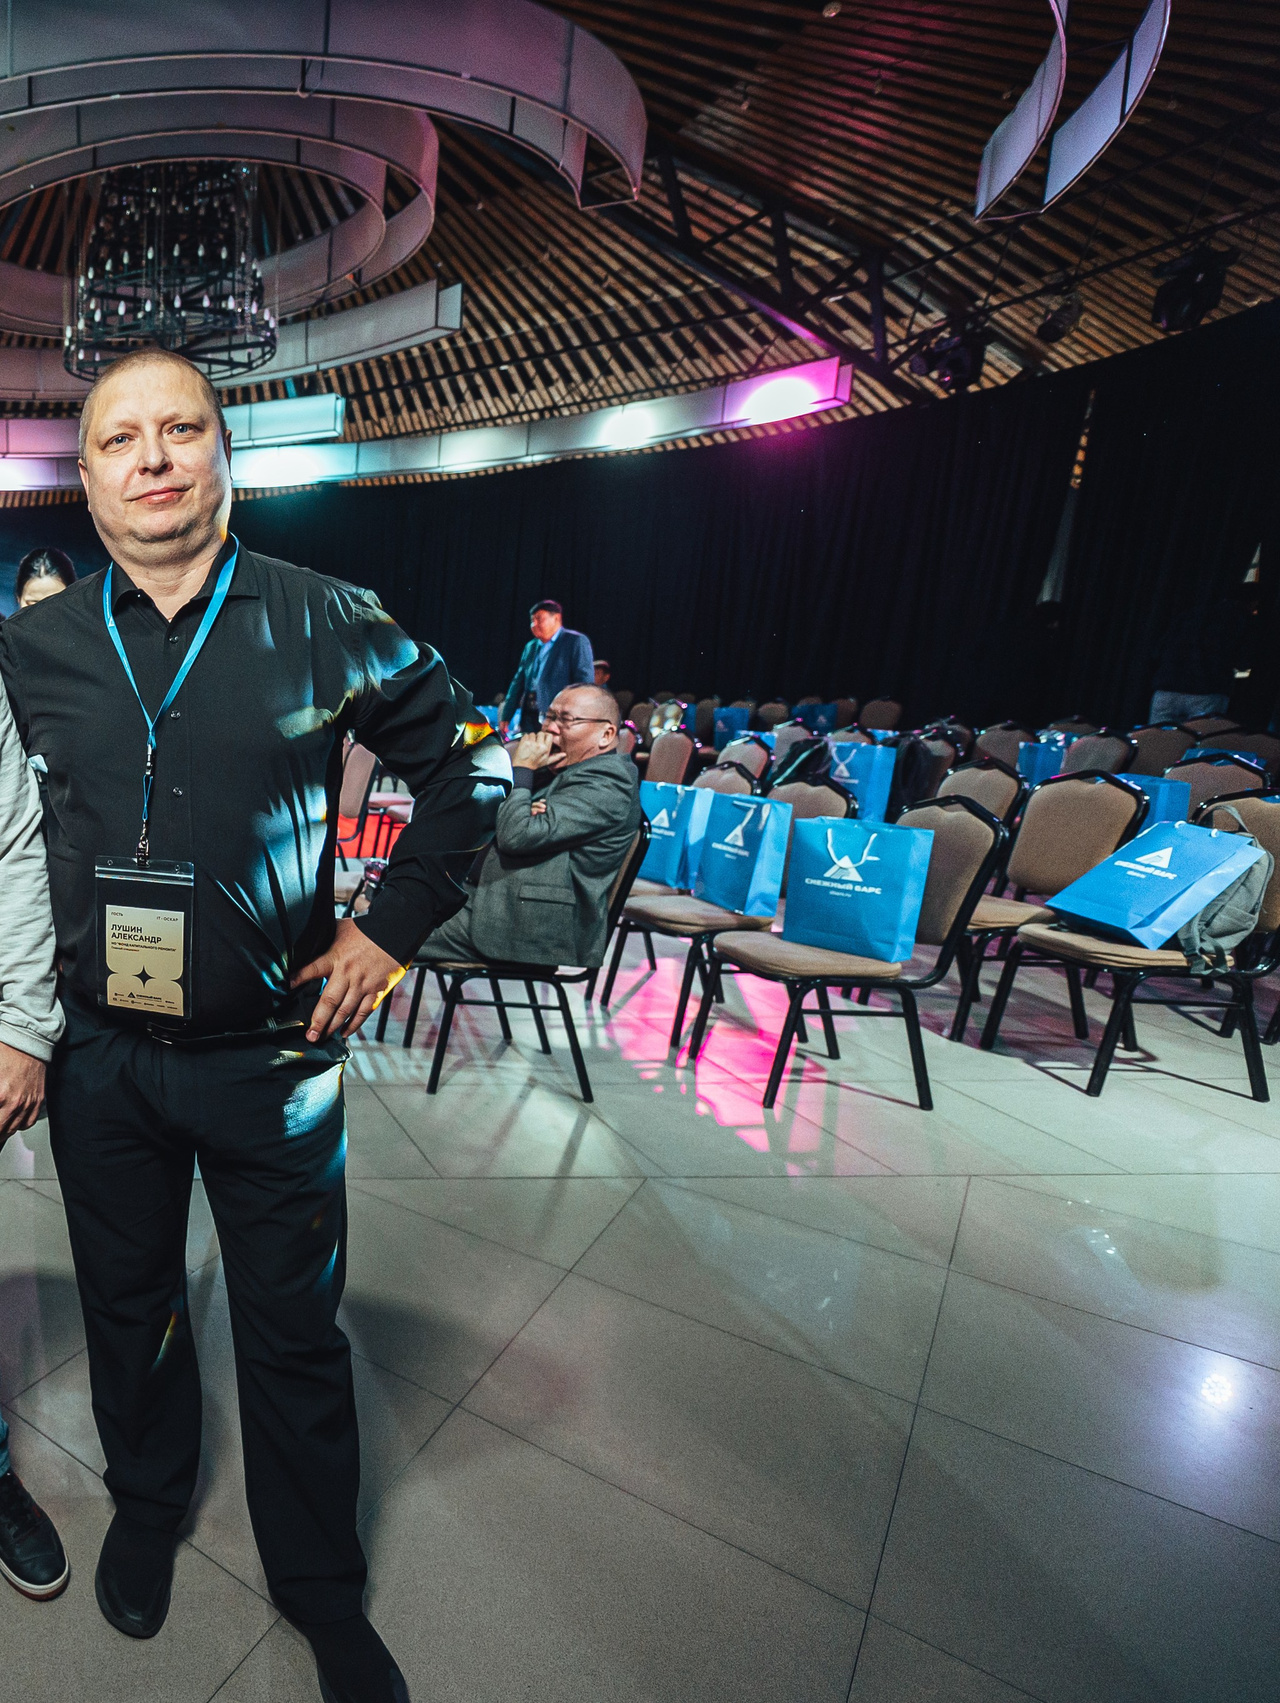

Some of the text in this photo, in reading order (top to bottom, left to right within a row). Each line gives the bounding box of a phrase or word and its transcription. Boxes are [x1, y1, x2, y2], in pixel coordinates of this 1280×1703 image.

[805, 878, 882, 895] СНЕЖНЫЙ БАРС
[111, 923, 143, 934] ЛУШИН
[111, 932, 162, 944] АЛЕКСАНДР
